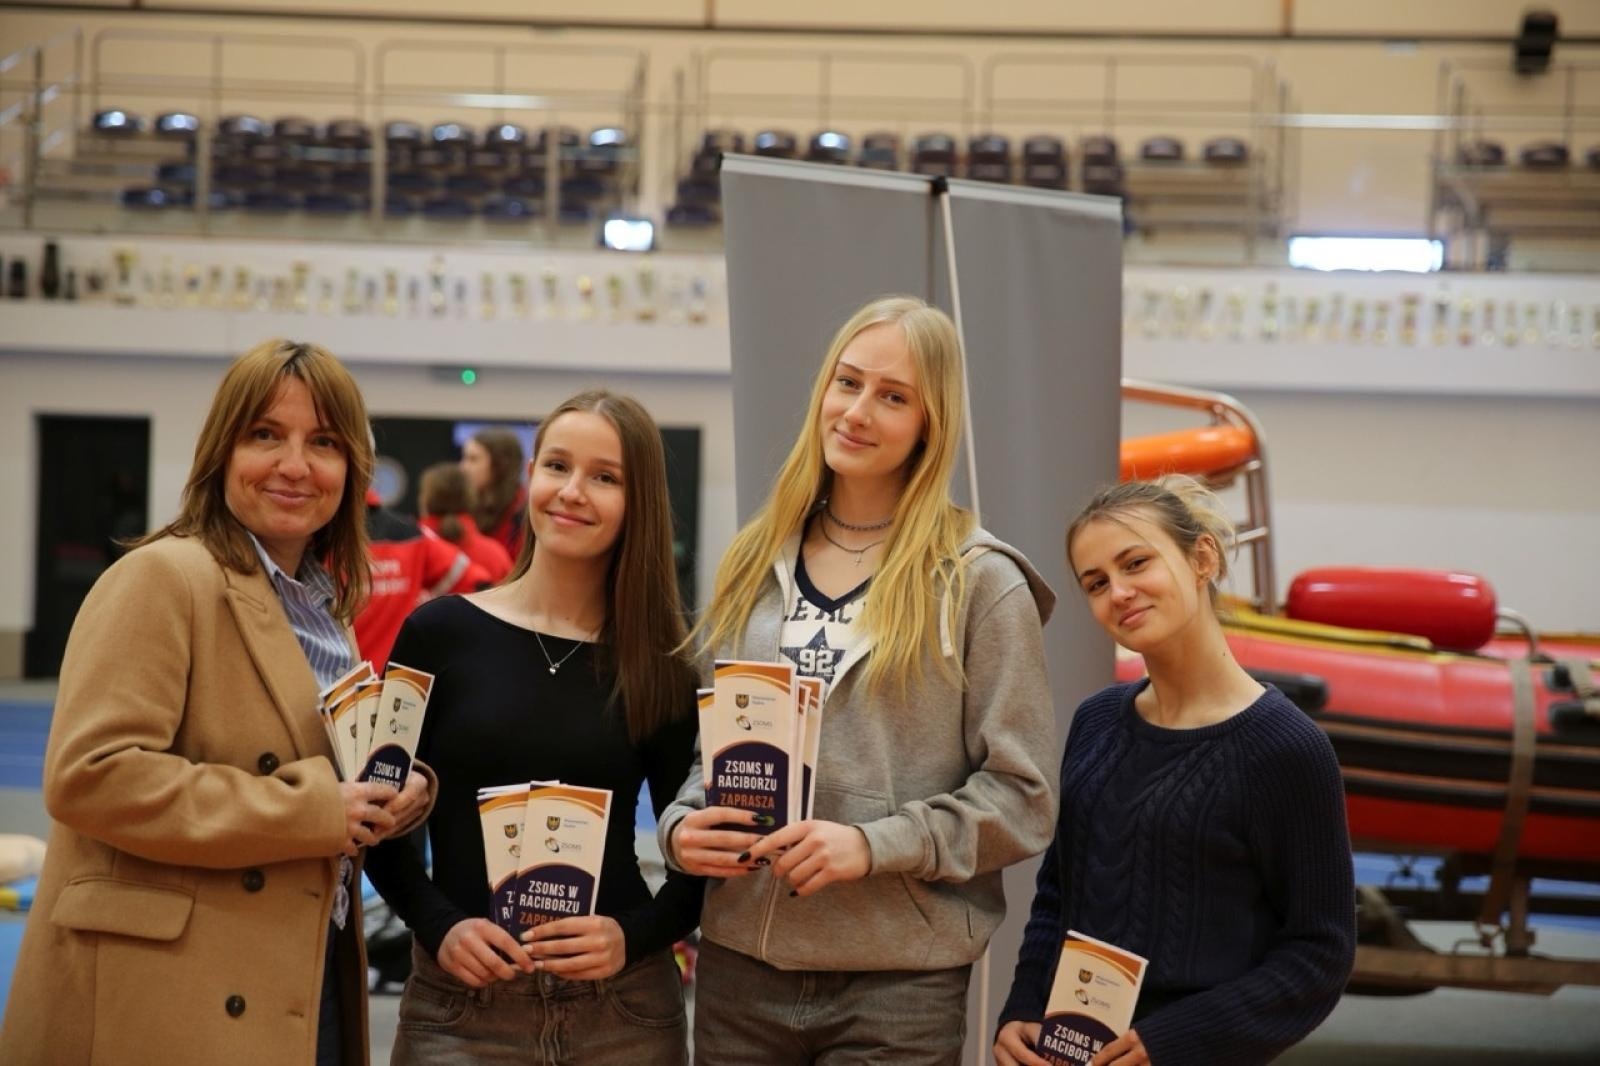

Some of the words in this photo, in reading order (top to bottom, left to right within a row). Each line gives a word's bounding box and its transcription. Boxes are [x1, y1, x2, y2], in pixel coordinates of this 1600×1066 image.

[800, 649, 834, 673] 92
[724, 760, 762, 775] ZSOMS
[764, 763, 775, 776] W
[718, 775, 778, 791] RACIBORZU
[719, 793, 775, 808] ZAPRASZA
[528, 880, 566, 897] ZSOMS
[568, 885, 579, 898] W
[519, 893, 580, 914] RACIBORZU
[1054, 1024, 1091, 1048] ZSOMS
[1092, 1039, 1104, 1052] W
[1044, 1034, 1095, 1063] RACIBOR
